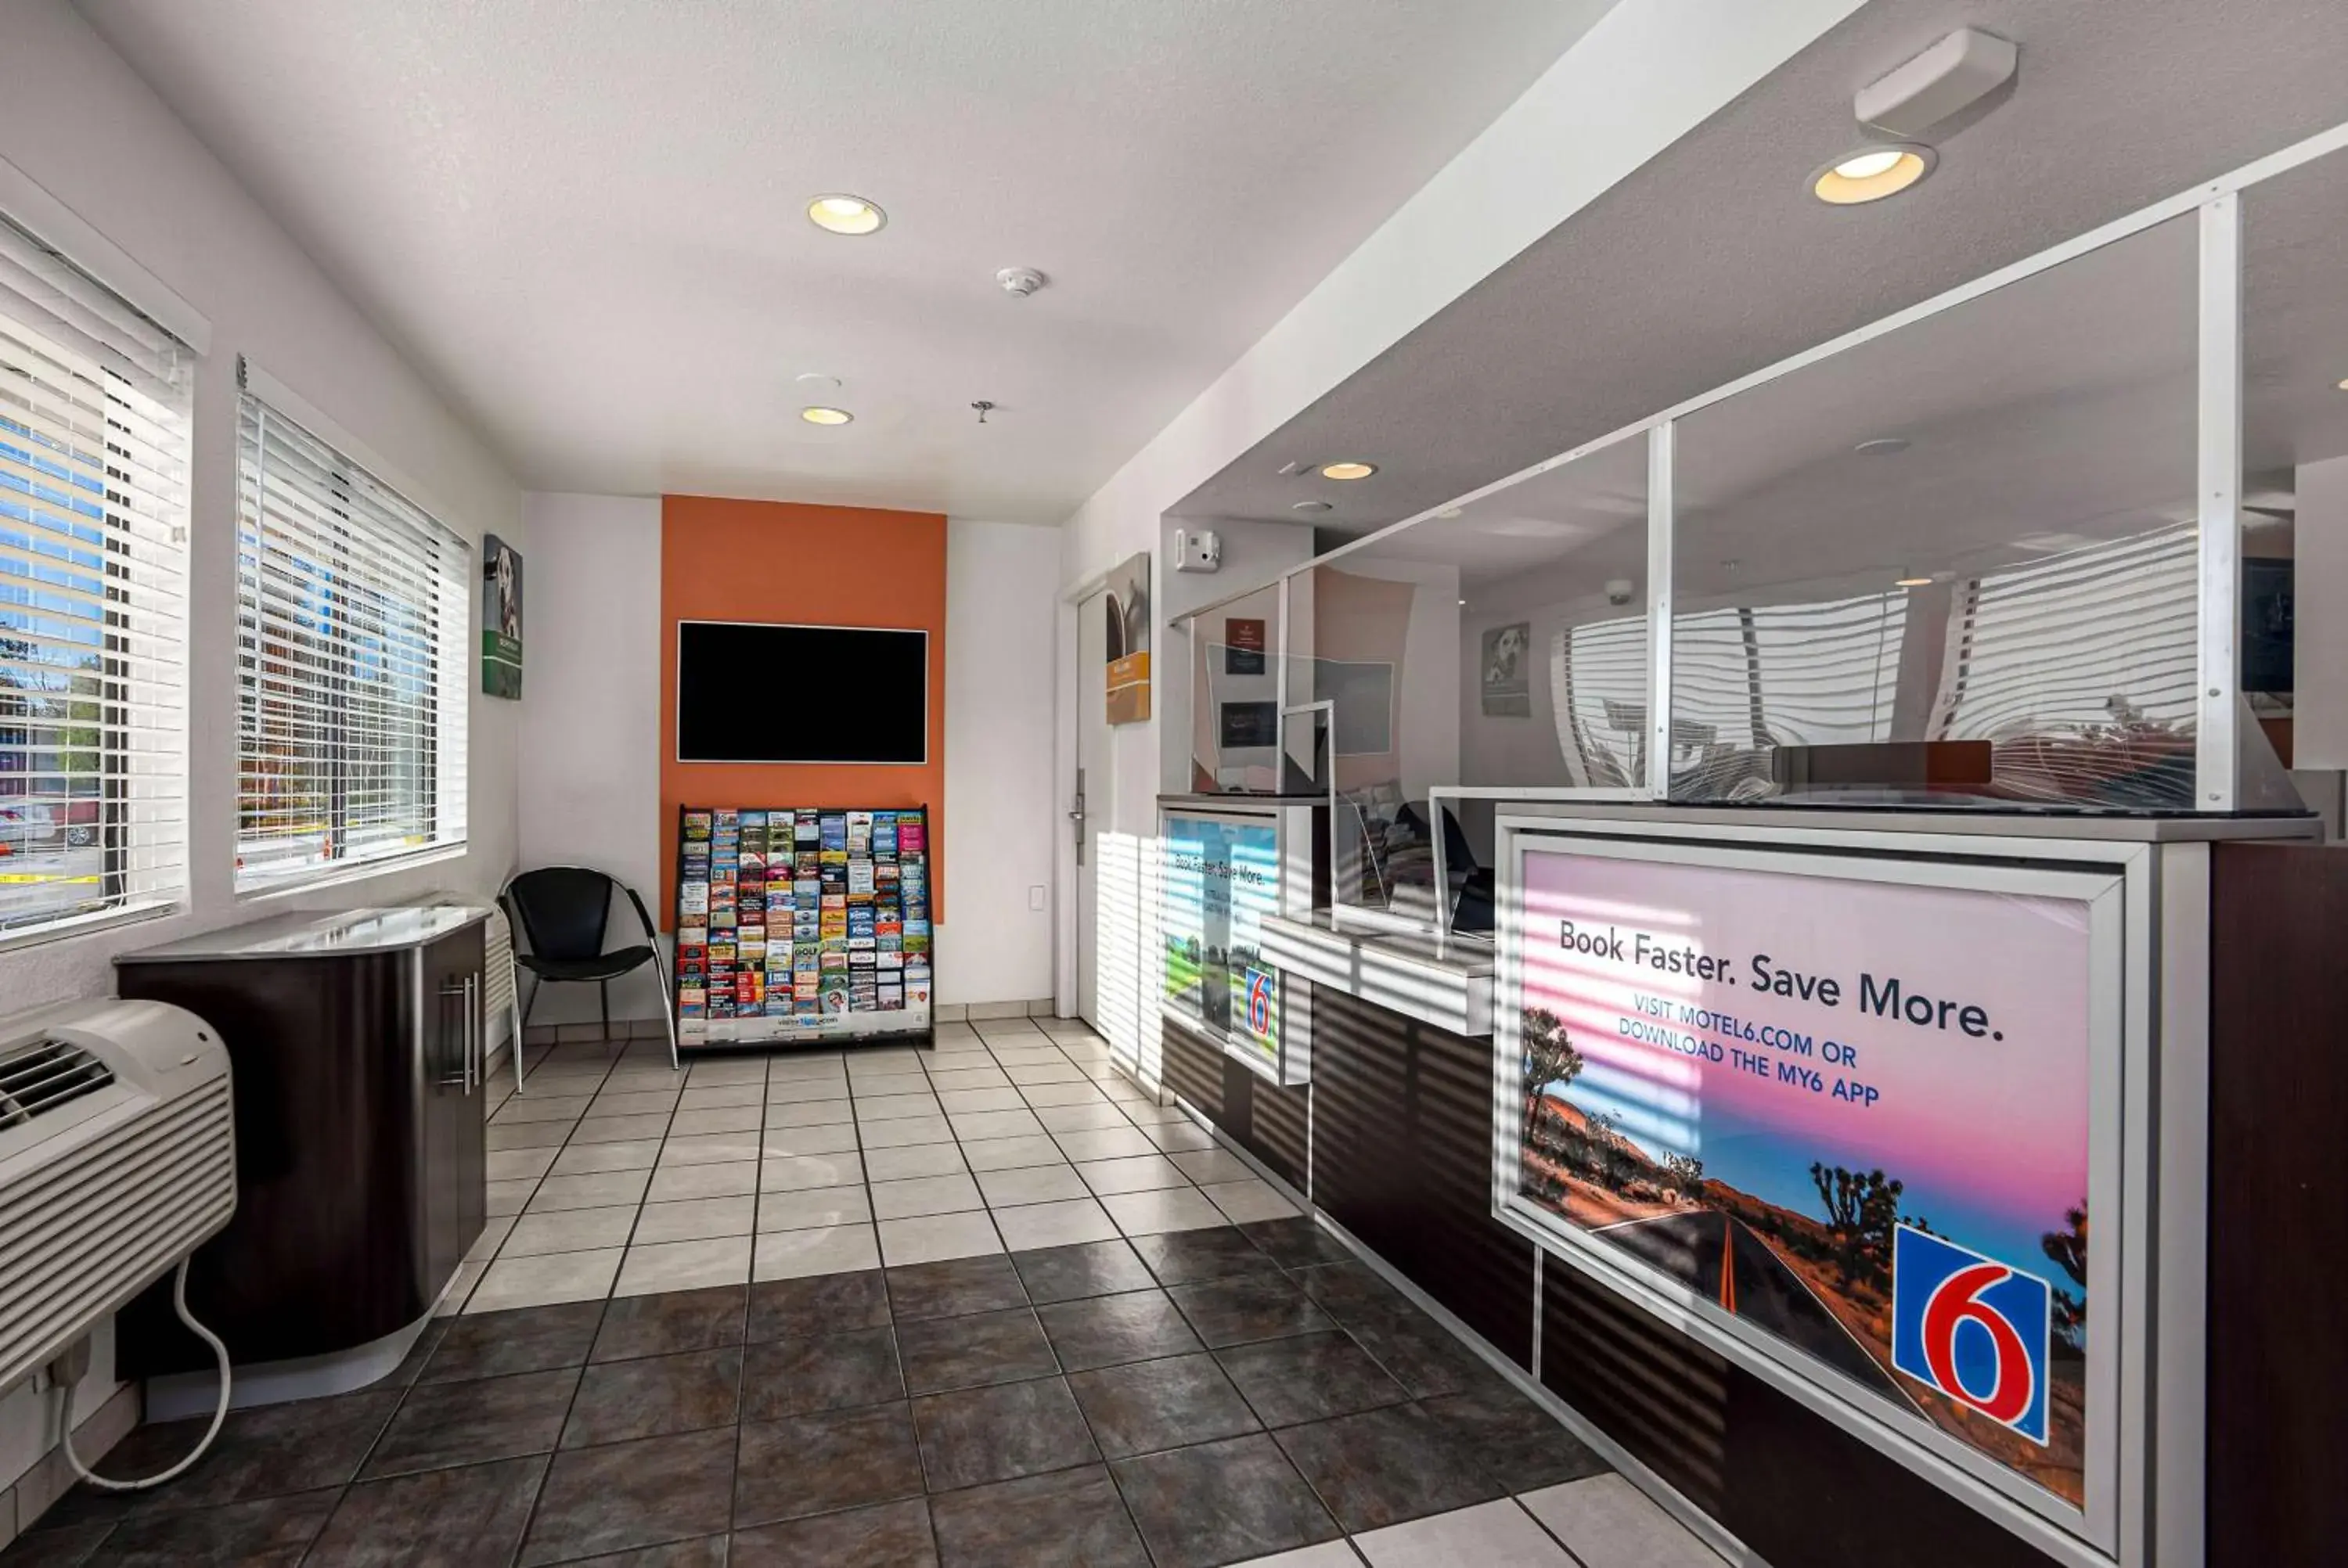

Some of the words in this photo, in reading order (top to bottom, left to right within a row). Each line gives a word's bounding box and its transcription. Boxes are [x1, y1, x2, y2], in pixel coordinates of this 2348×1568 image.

[1251, 975, 1269, 1037] 6
[1560, 919, 1624, 962] Book
[1634, 933, 1735, 985] Faster.
[1750, 954, 1841, 1007] Save
[1860, 973, 2004, 1042] More.
[1619, 1018, 1724, 1063] DOWNLOAD
[1730, 1048, 1770, 1077] THE
[1777, 1062, 1824, 1093] MY6
[1831, 1079, 1879, 1107] APP
[1633, 993, 1673, 1019] VISIT
[1679, 1005, 1813, 1057] MOTEL6.COM
[1821, 1041, 1857, 1069] OR
[1921, 1261, 2035, 1427] 6
